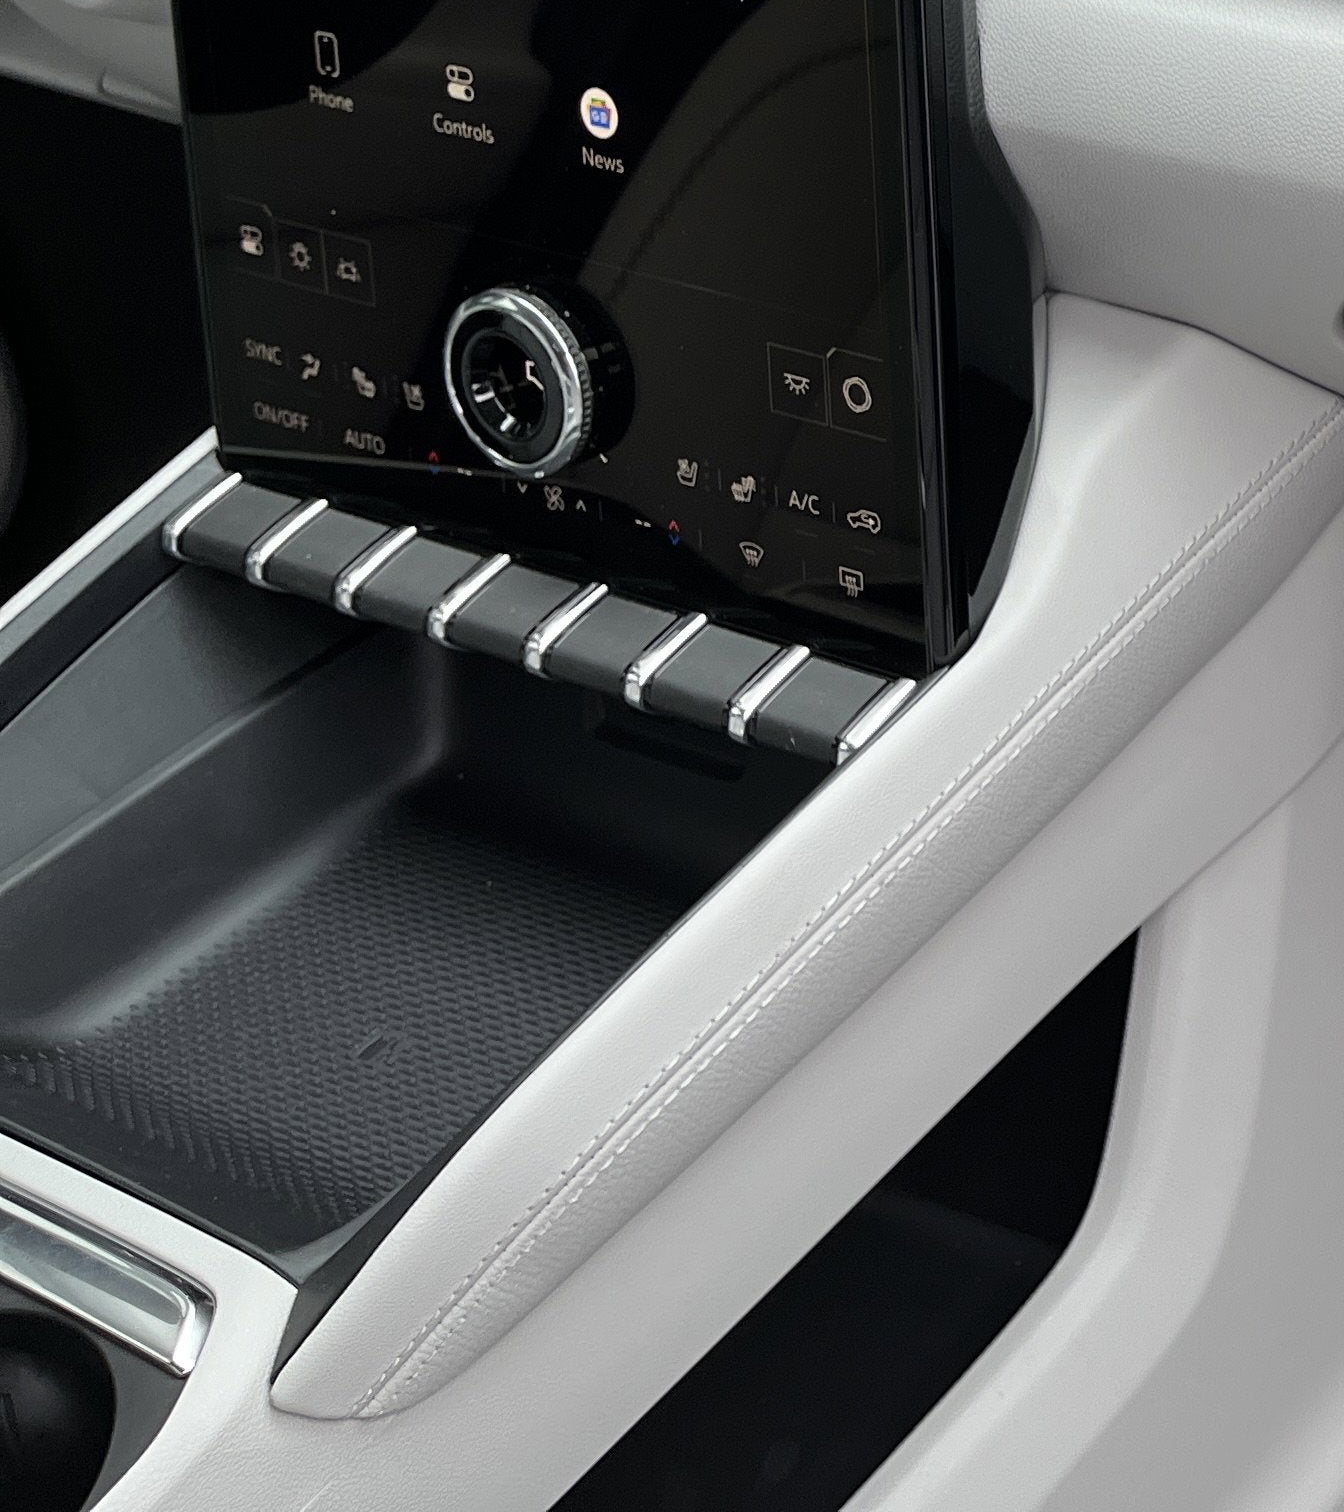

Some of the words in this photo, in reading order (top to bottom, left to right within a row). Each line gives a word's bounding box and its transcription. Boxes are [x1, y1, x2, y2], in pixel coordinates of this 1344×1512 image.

[308, 85, 354, 113] Phone
[433, 113, 495, 145] Controls
[582, 146, 625, 174] News
[245, 338, 283, 367] SYNC
[253, 400, 310, 433] ON/OFF
[344, 428, 386, 455] AUTO
[788, 490, 820, 515] A/C
